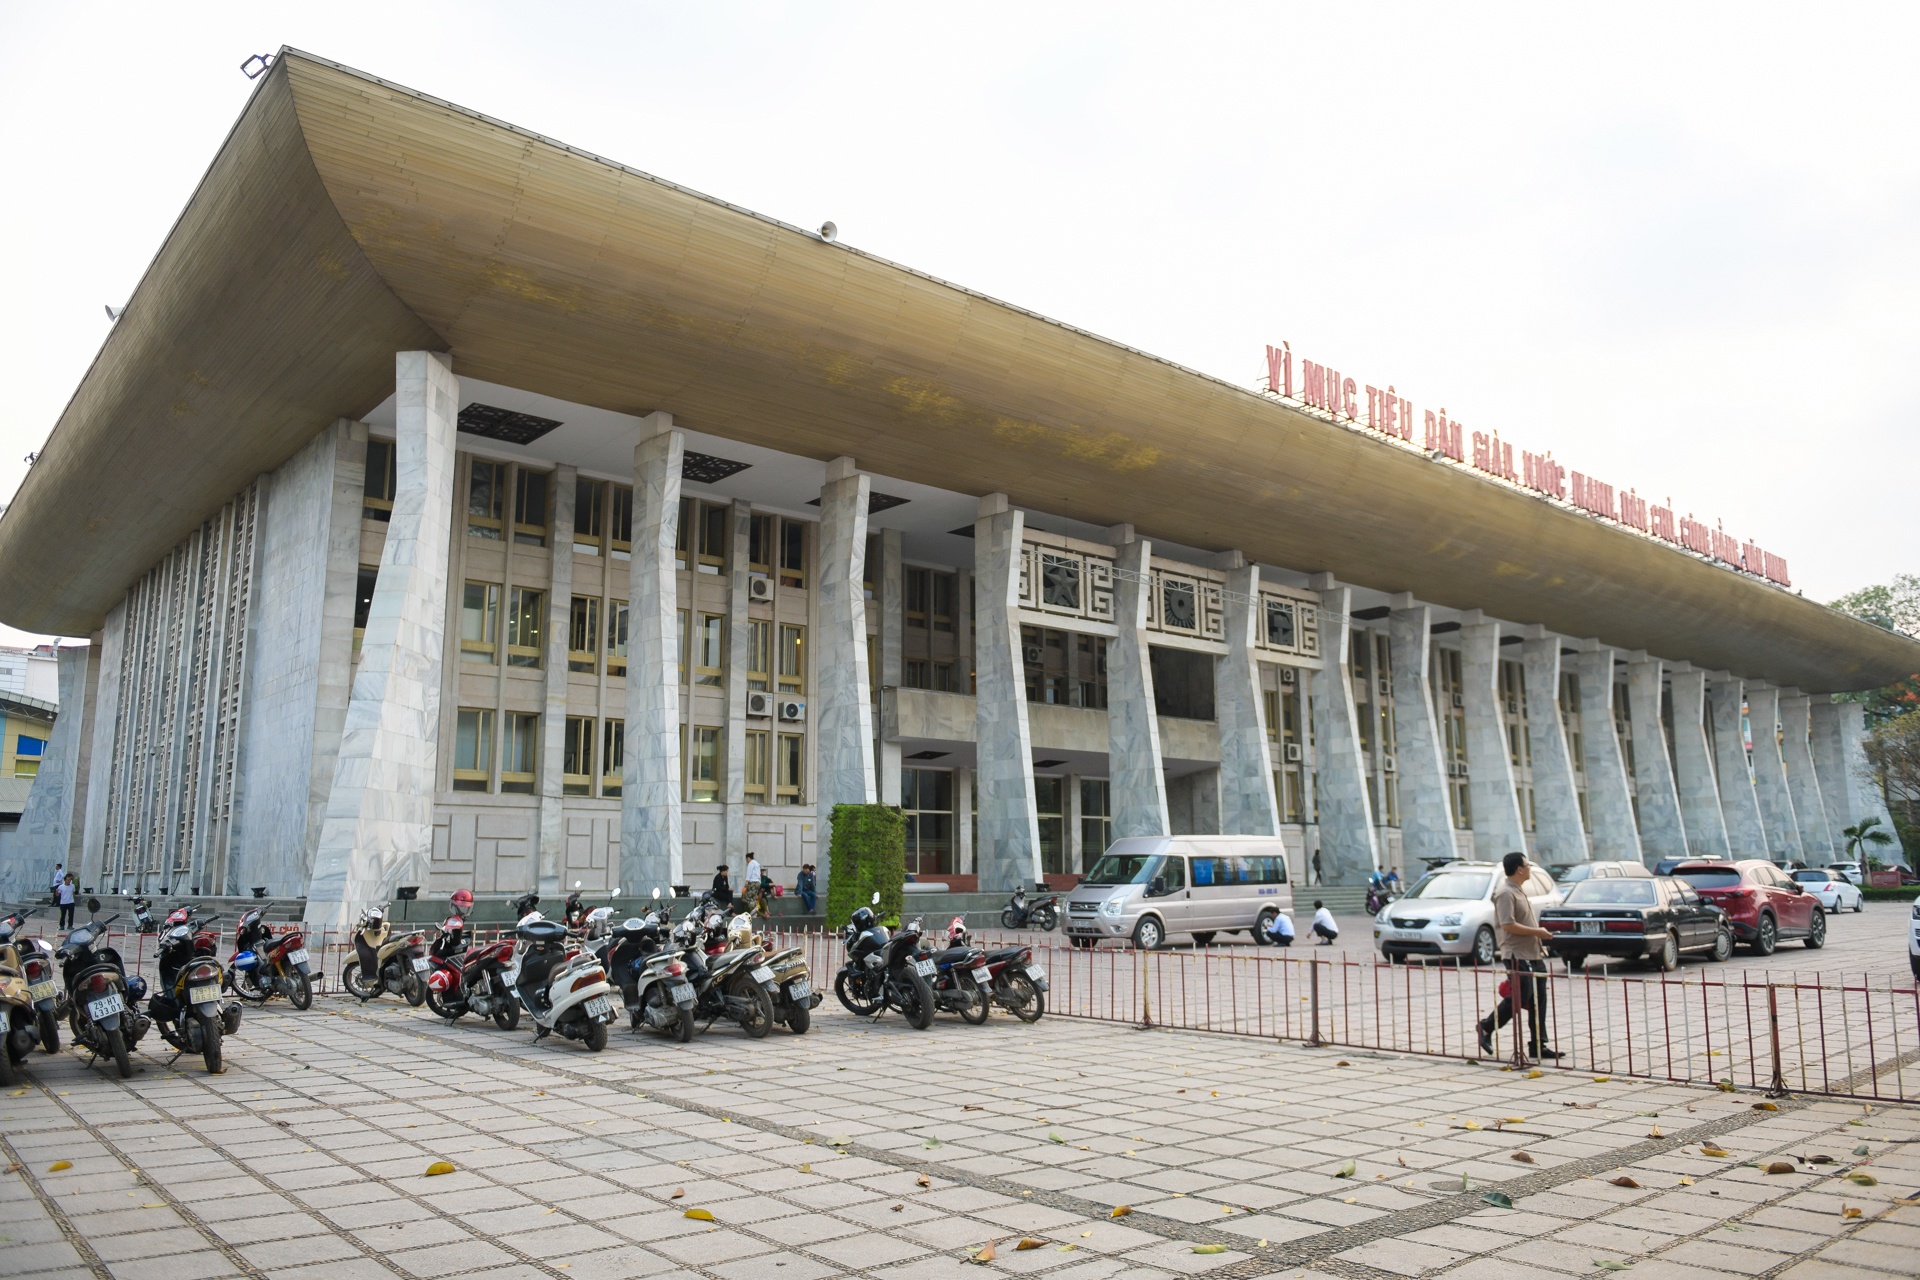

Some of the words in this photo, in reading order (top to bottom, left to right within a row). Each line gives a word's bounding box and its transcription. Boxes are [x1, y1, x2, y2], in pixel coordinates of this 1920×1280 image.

[1266, 340, 1292, 398] VÌ
[1303, 359, 1358, 422] MỤC
[1366, 385, 1412, 442] TIÊU
[1425, 408, 1463, 462] DÂN
[94, 1003, 121, 1018] 433.01
